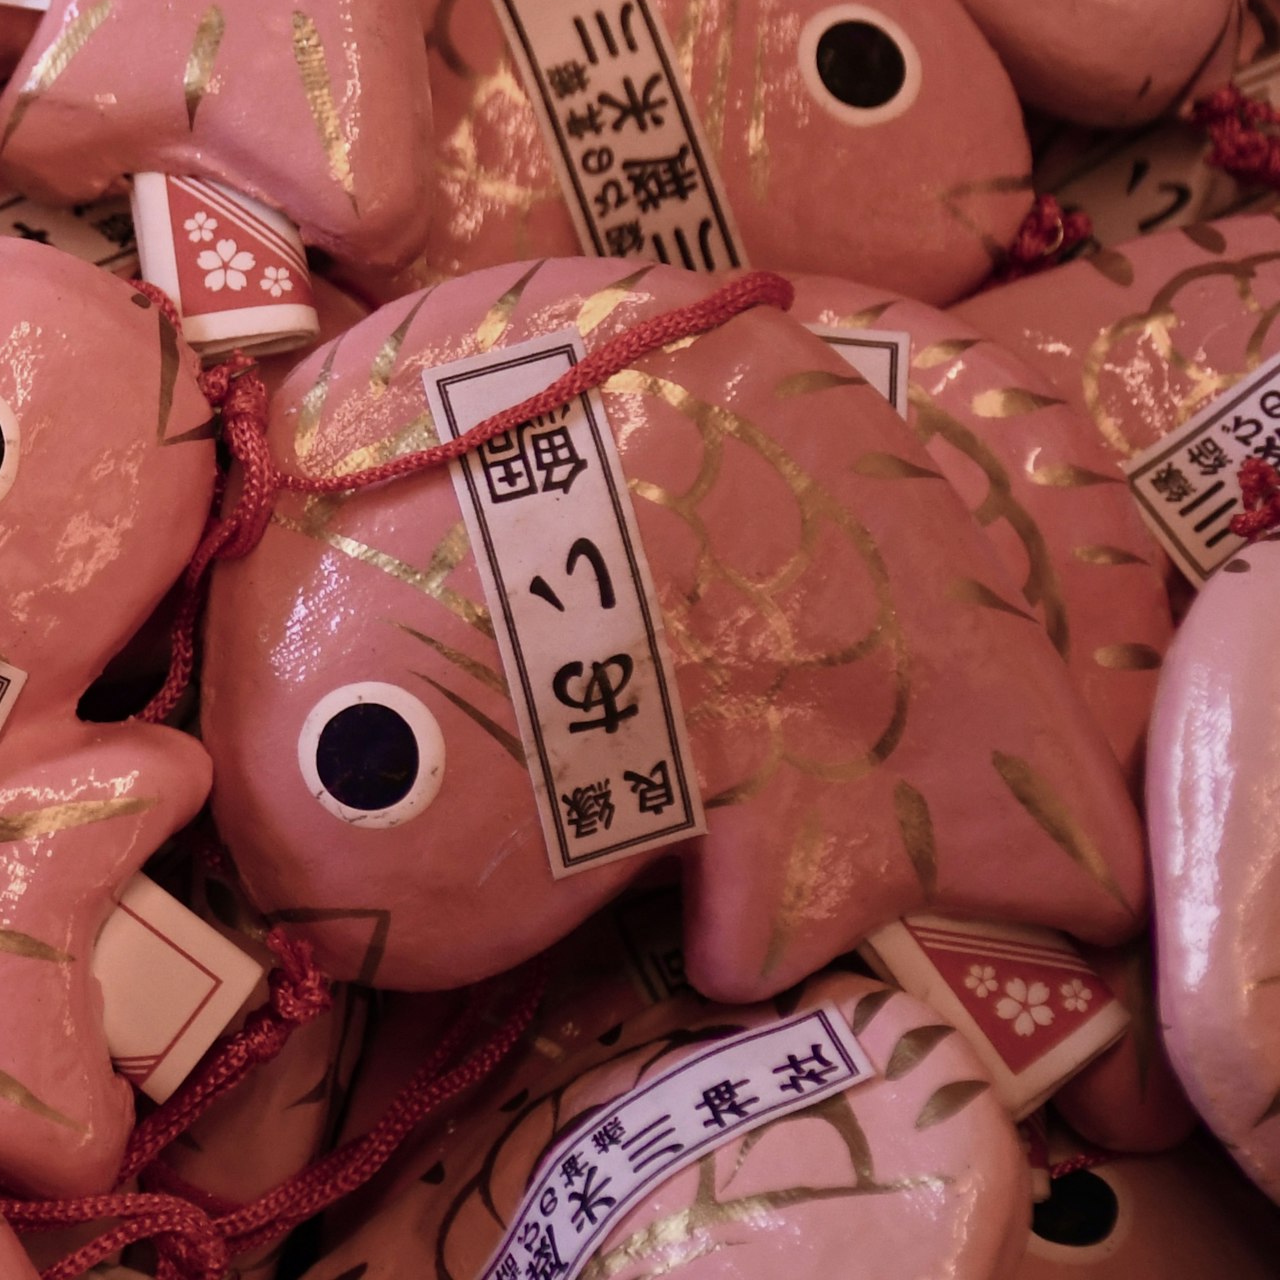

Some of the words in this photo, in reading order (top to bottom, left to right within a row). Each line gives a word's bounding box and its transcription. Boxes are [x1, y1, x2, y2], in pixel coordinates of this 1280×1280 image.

[479, 402, 640, 734] あい鯛
[561, 760, 675, 839] 良縁
